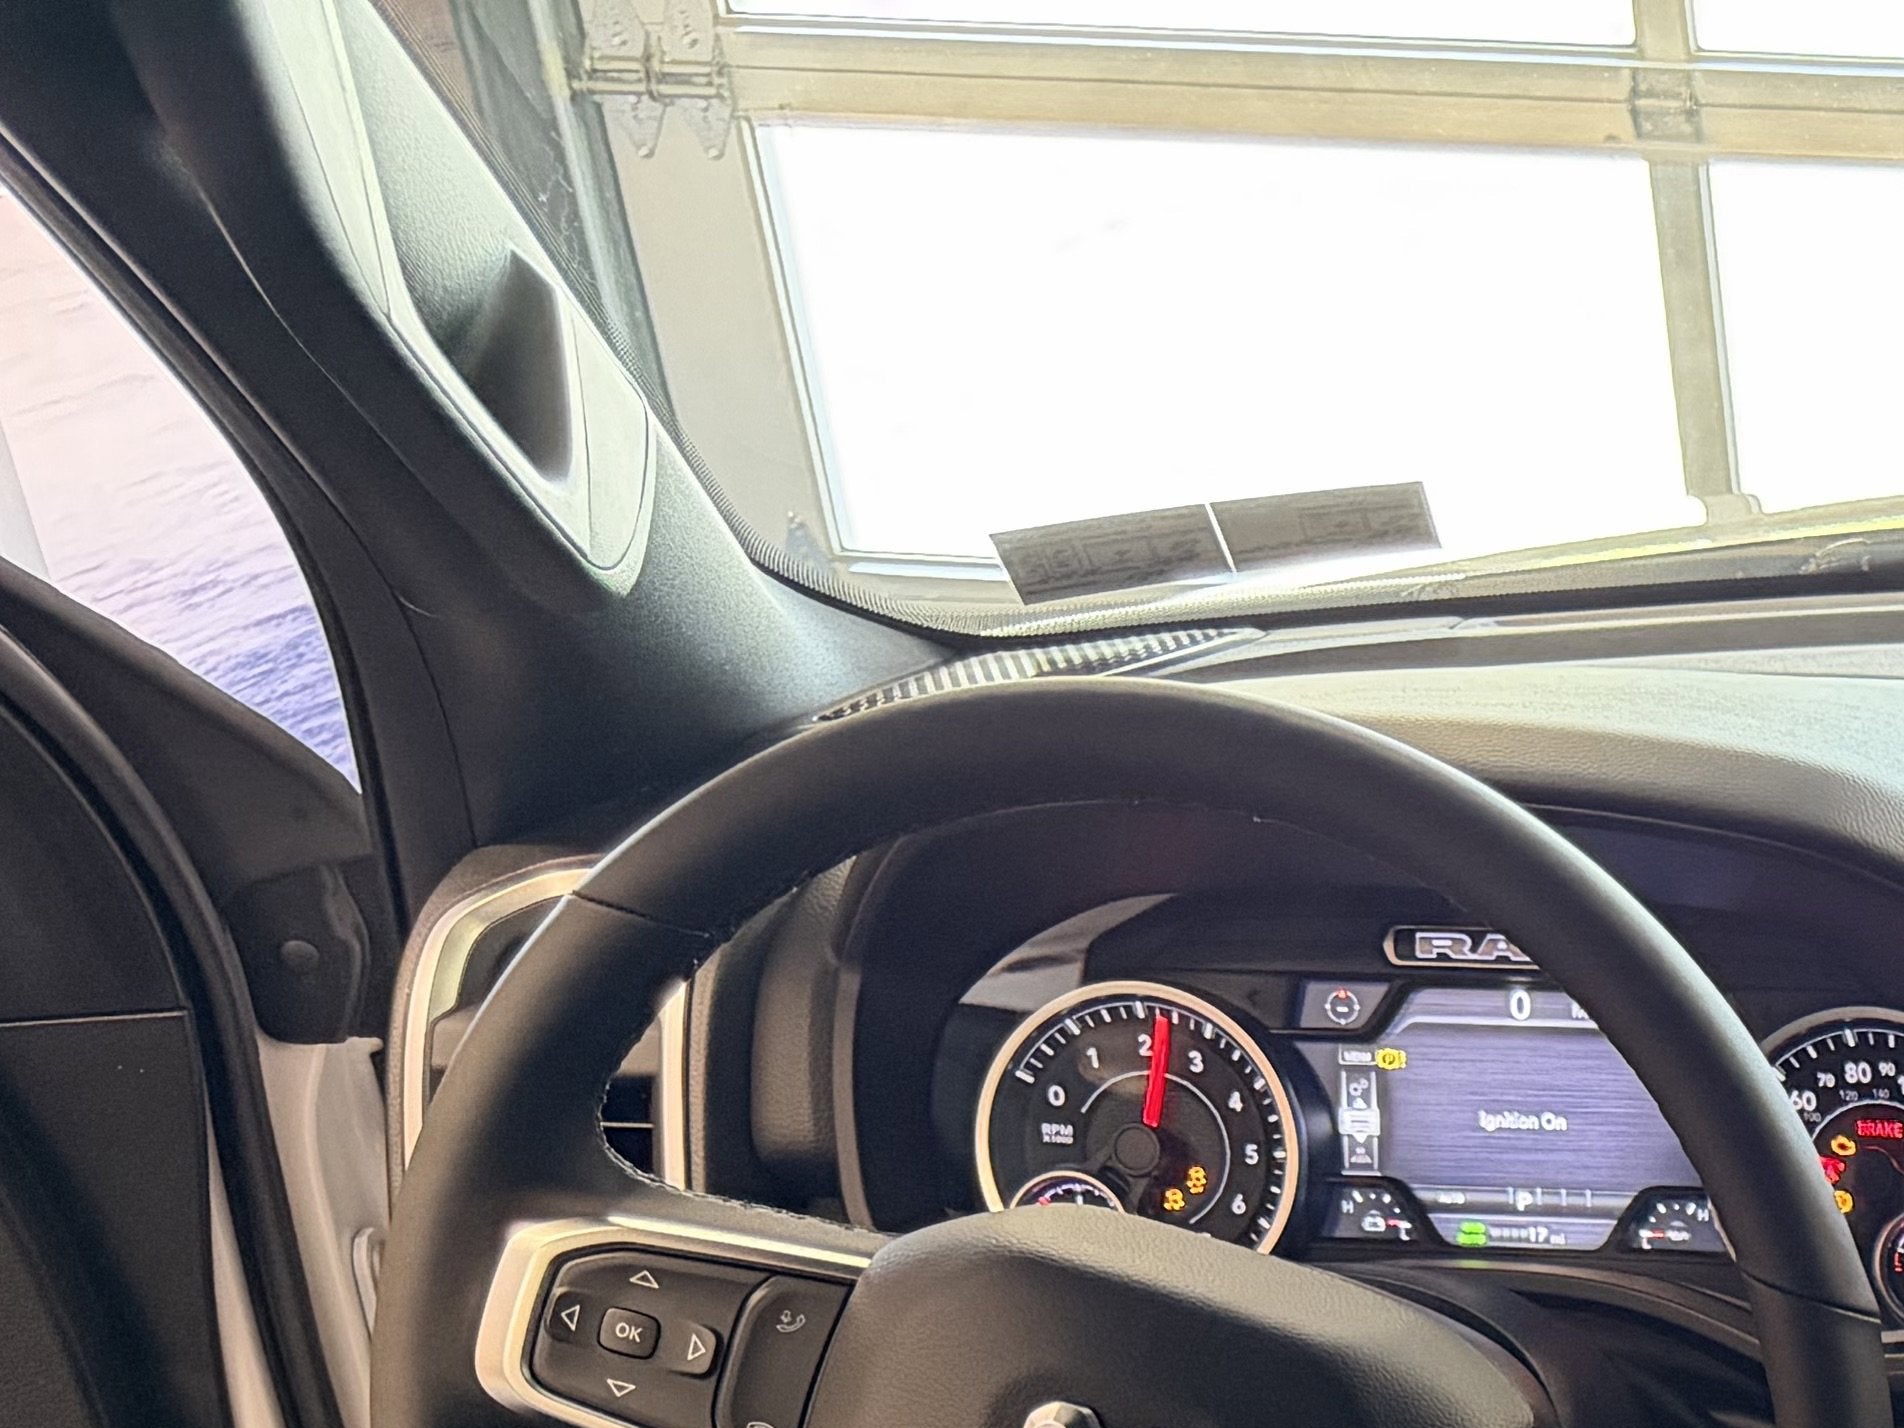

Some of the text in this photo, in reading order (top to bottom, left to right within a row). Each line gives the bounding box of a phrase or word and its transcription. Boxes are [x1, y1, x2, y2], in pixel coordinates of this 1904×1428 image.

[1509, 990, 1532, 1021] 0
[1138, 1034, 1154, 1057] 2
[1087, 1048, 1099, 1068] 1
[1189, 1051, 1204, 1073] 3
[1844, 1062, 1872, 1084] 80
[1878, 1061, 1896, 1077] 90
[1817, 1072, 1835, 1088] 70
[1048, 1085, 1066, 1106] 0
[1228, 1091, 1243, 1112] 4
[1791, 1090, 1817, 1111] 60
[1041, 1122, 1074, 1137] RPM
[1479, 1110, 1568, 1132] Ignition On
[1856, 1120, 1904, 1138] BRAKE
[1245, 1144, 1259, 1165] 5
[1232, 1193, 1246, 1215] 6
[615, 1321, 642, 1343] OK
